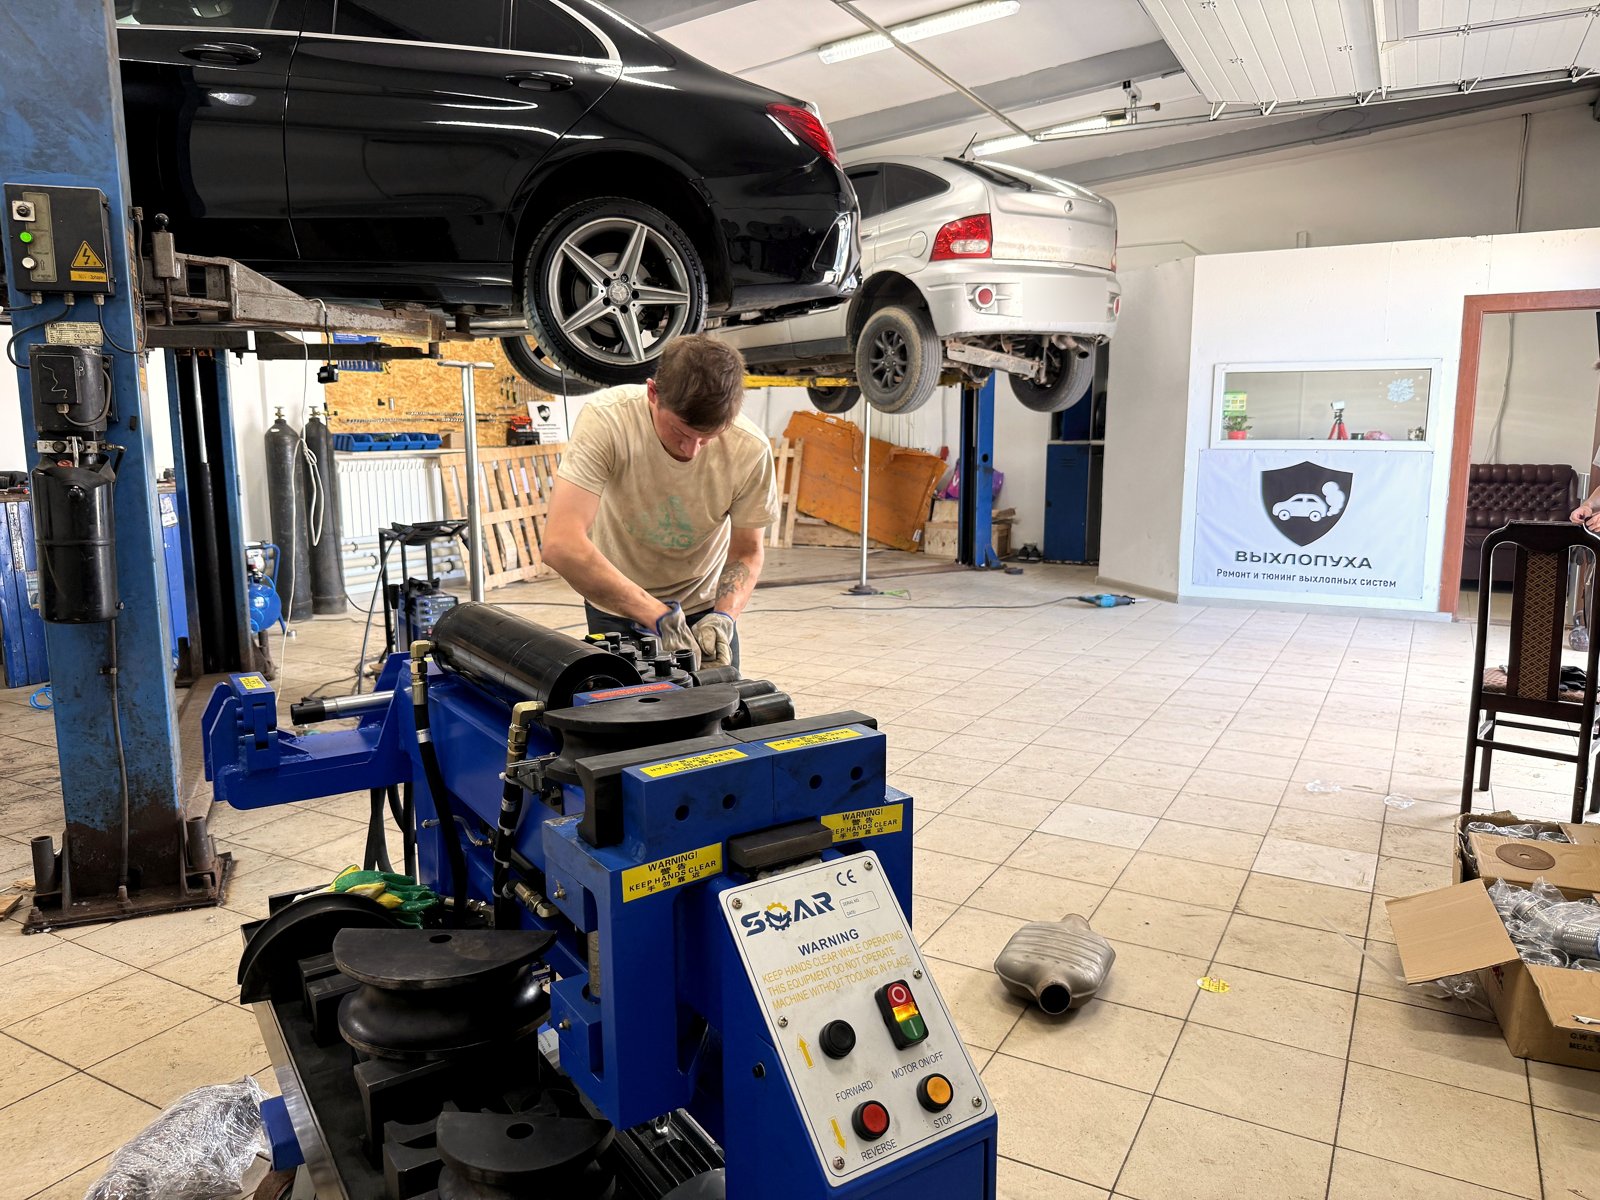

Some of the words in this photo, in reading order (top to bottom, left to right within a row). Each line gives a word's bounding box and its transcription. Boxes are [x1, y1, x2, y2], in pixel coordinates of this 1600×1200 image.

[1235, 550, 1372, 569] ВЫХЛОПУХА
[1216, 568, 1251, 579] Ремонт
[1261, 573, 1296, 582] тюнинг
[1299, 575, 1357, 586] выхлопных
[1360, 578, 1397, 588] систем
[842, 808, 883, 821] WARNING!
[846, 823, 873, 833] HANDS
[874, 819, 898, 828] CLEAR
[648, 851, 698, 872] WARNING!
[629, 880, 652, 892] KEEP
[654, 869, 687, 885] HANDS
[688, 860, 717, 874] CLEAR
[740, 891, 836, 937] SOAR
[797, 928, 860, 957] WARNING
[762, 969, 784, 984] KEEP
[786, 960, 812, 977] HANDS
[812, 951, 838, 967] CLEAR
[839, 943, 863, 959] WHILE
[862, 930, 905, 951] OPERATING
[767, 983, 787, 998] THIS
[787, 967, 832, 992] EQUIPMENT
[833, 964, 845, 975] DO
[845, 957, 861, 972] NOT
[862, 945, 897, 965] OPERATE
[772, 990, 810, 1010] MACHINE
[810, 978, 845, 996] WITHOUT
[845, 967, 878, 985] TOOLING
[879, 963, 888, 974] IN
[888, 954, 913, 970] PLACE
[891, 1062, 919, 1079] MOTOR
[918, 1051, 944, 1068] ON/OFF
[835, 1080, 874, 1103] FORWARD
[933, 1113, 953, 1129] STOP
[860, 1138, 897, 1162] REVERSE
